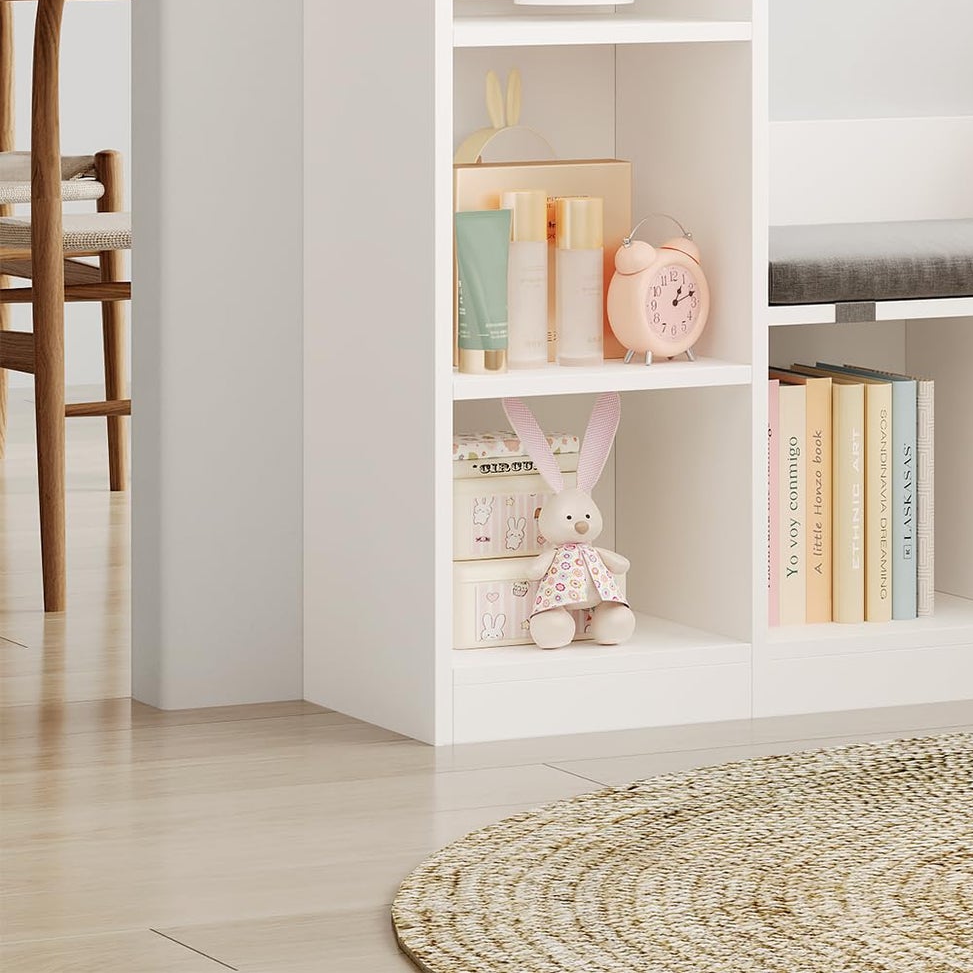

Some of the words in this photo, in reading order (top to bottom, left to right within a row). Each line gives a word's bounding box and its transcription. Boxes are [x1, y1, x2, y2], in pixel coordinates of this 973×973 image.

[661, 275, 667, 286] 11
[670, 271, 678, 282] 12
[653, 286, 662, 297] 10
[651, 300, 657, 311] 9
[690, 297, 696, 308] 3
[653, 313, 660, 323] 8
[687, 310, 693, 321] 4
[662, 322, 667, 333] 7
[671, 325, 676, 335] 6
[681, 320, 687, 332] 5
[812, 430, 823, 464] book
[852, 429, 861, 473] ART
[480, 461, 537, 473] CIRCU
[880, 409, 888, 513] SCANDINAVIA
[787, 436, 801, 511] conmigo
[813, 470, 823, 515] Honzo
[904, 444, 912, 540] LASKASAS
[852, 484, 861, 569] ETHNIC
[789, 518, 801, 548] voy
[812, 521, 823, 556] little
[880, 517, 888, 600] DREAMING
[786, 554, 799, 578] Yo
[813, 564, 823, 574] A
